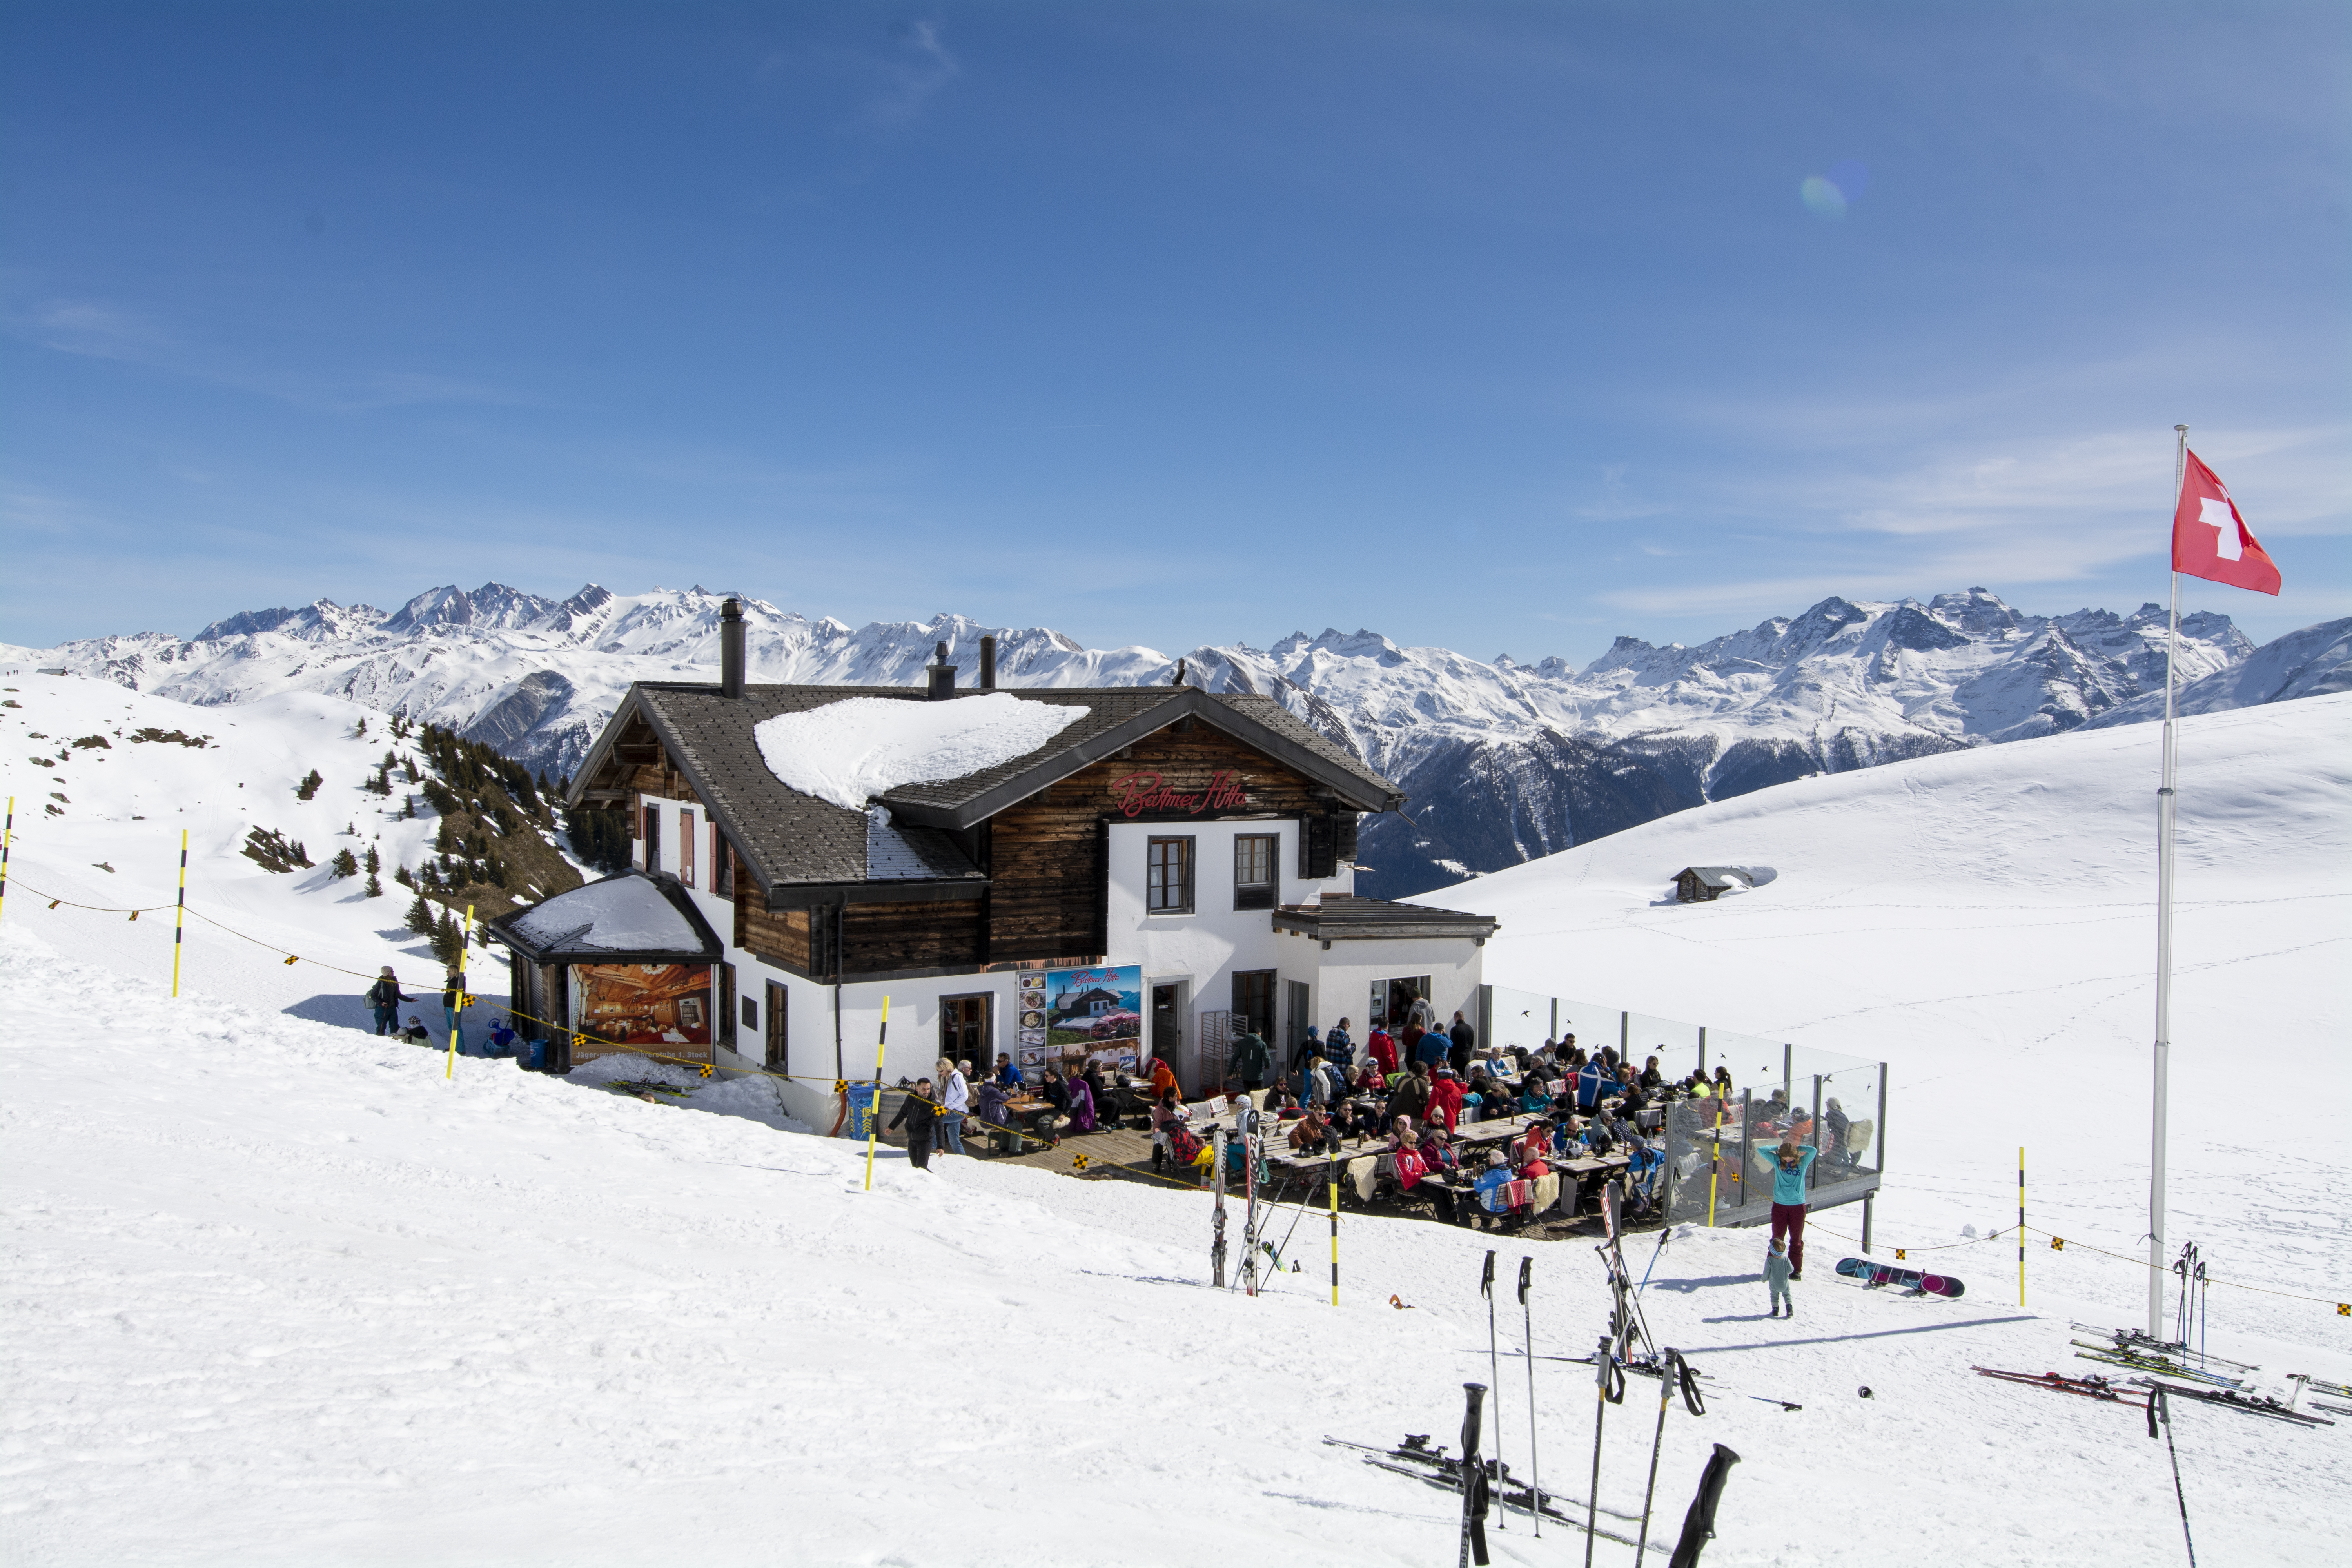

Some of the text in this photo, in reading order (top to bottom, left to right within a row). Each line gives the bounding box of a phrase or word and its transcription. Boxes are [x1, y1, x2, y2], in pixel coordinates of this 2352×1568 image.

[1112, 770, 1247, 817] Bättmer Hitta
[1098, 968, 1119, 985] Hitta
